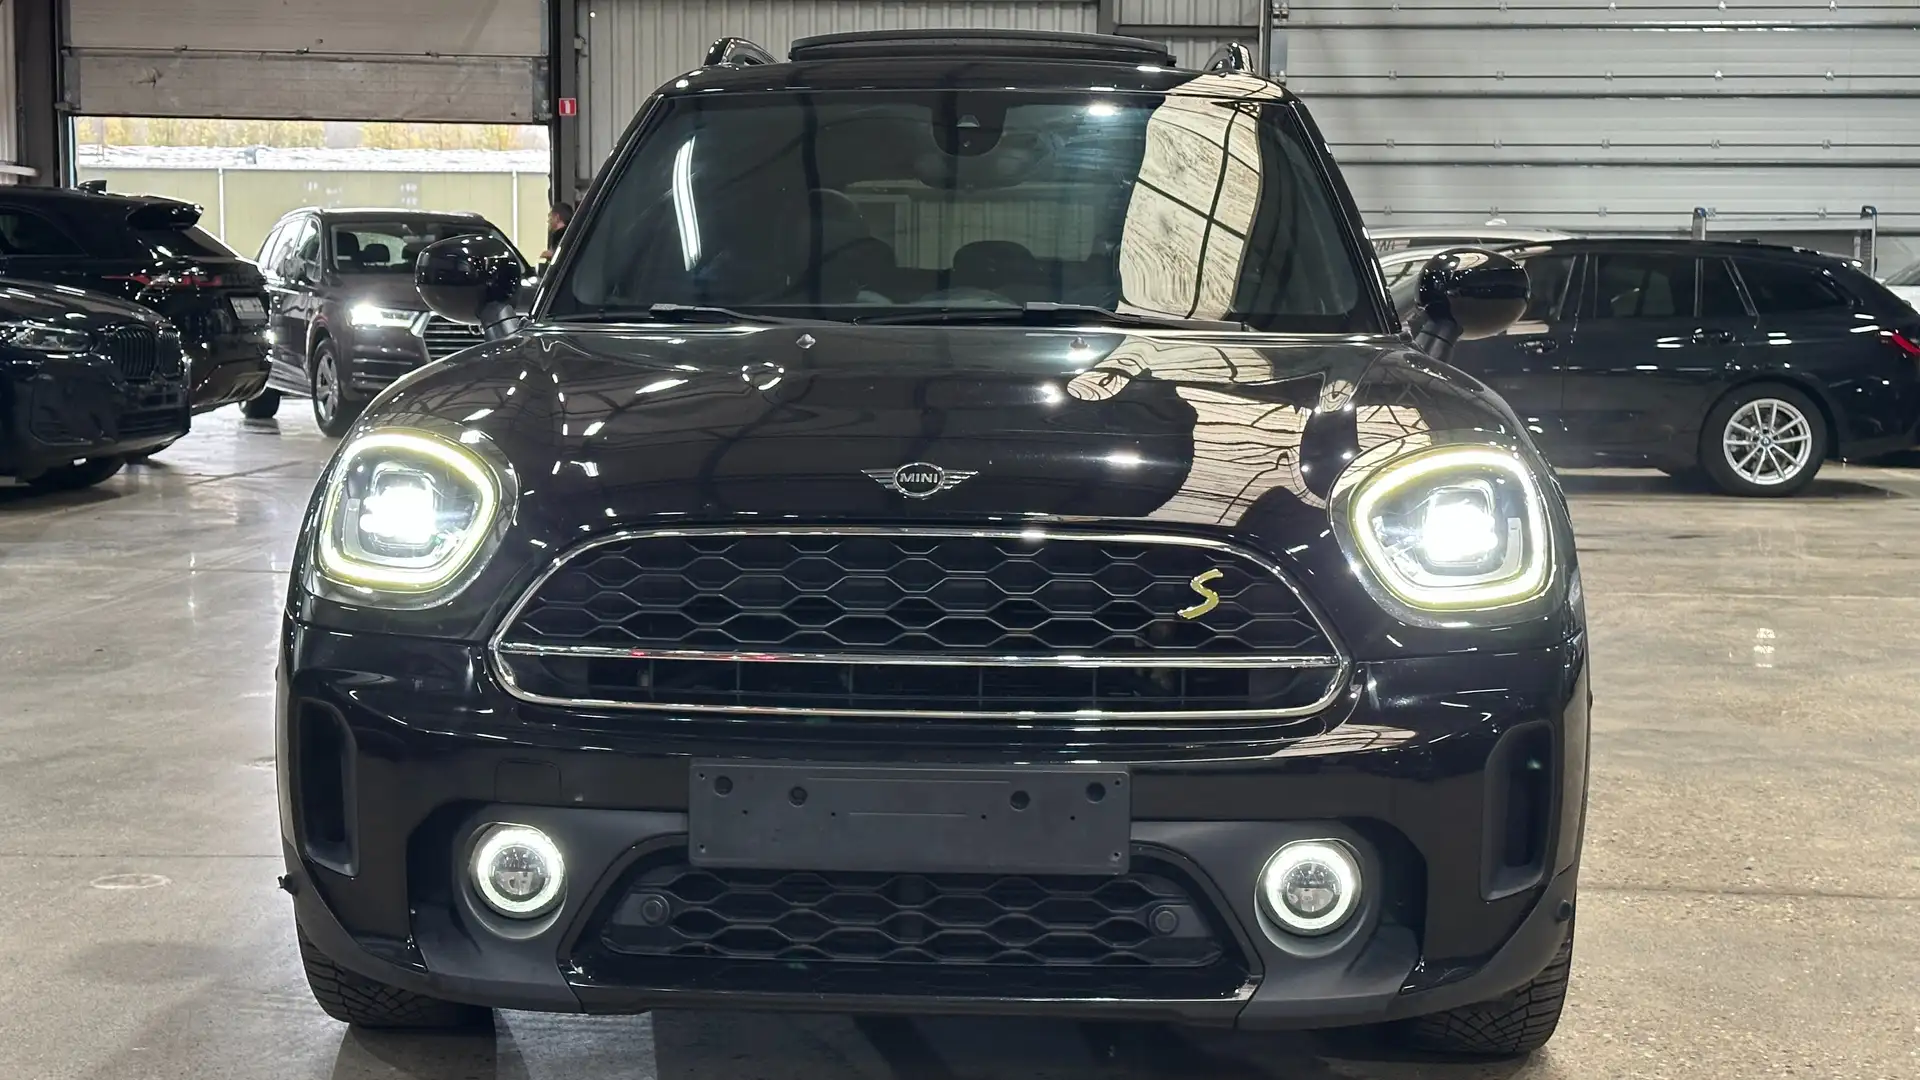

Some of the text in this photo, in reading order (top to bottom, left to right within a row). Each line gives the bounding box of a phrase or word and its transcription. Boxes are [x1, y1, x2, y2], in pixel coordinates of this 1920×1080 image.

[564, 100, 571, 114] 1
[900, 473, 938, 483] MINI
[1177, 568, 1223, 620] S
